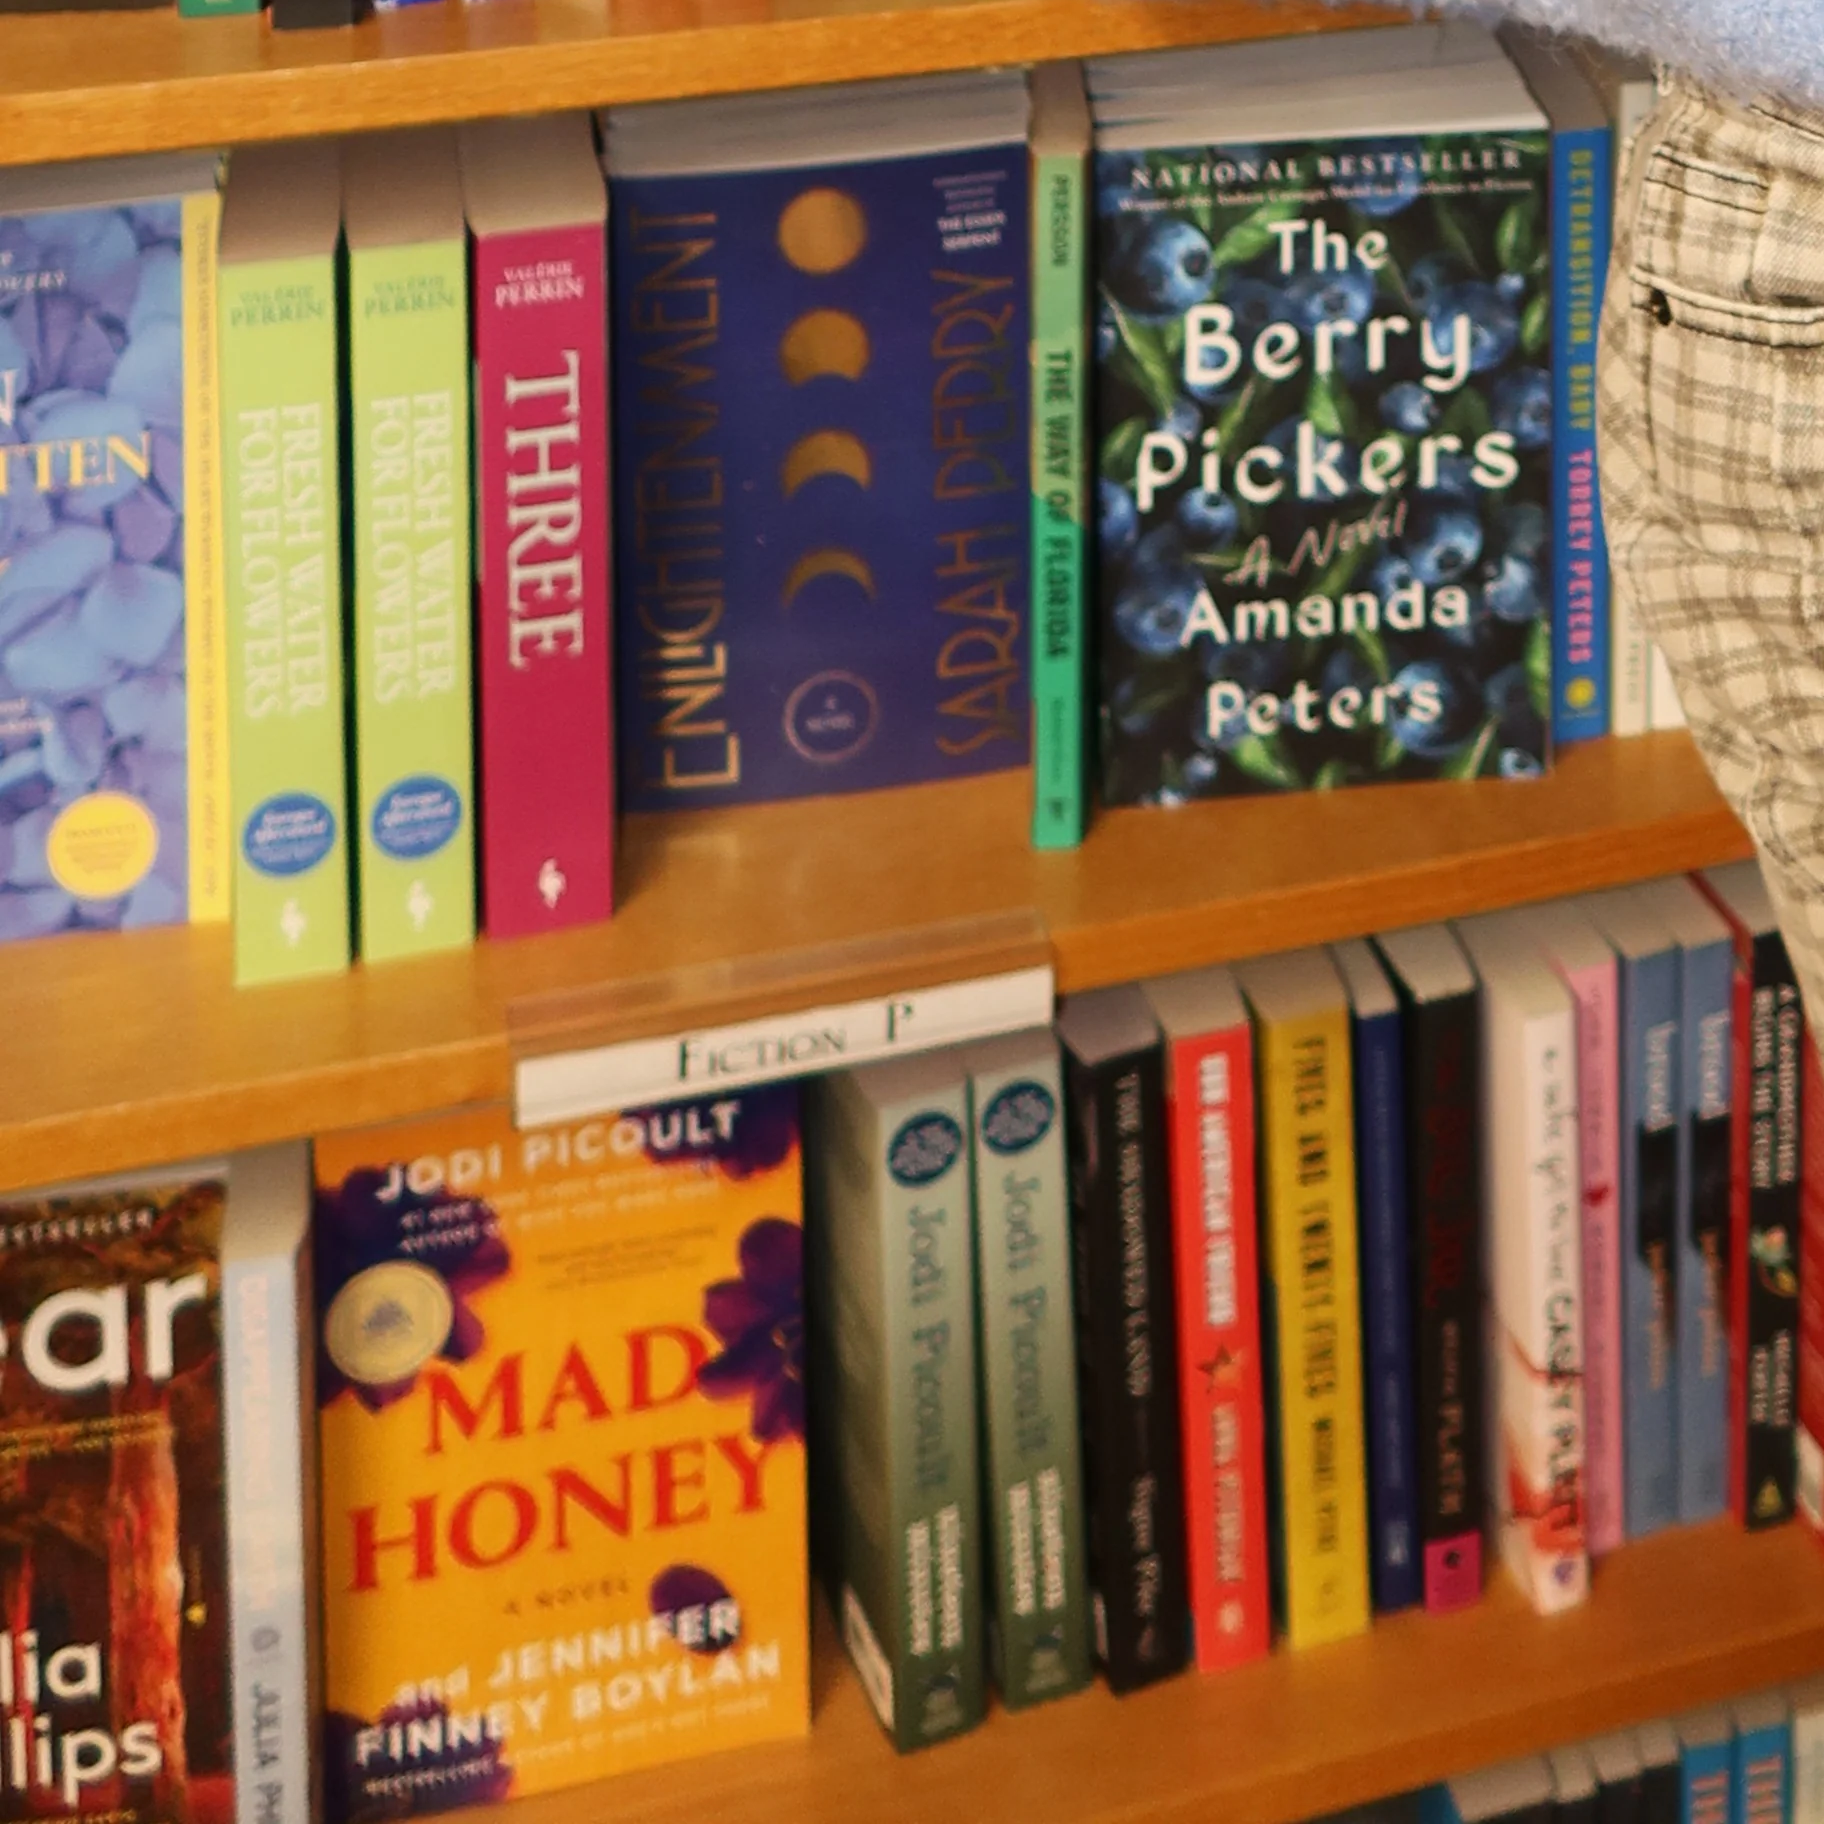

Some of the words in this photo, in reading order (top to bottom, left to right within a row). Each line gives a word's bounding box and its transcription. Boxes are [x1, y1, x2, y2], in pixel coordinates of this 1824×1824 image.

[1268, 219, 1390, 276] The
[1181, 304, 1473, 394] Berry
[239, 406, 278, 504] FOR
[281, 403, 323, 547] FRESH
[1135, 420, 1520, 514] Pickers
[505, 349, 583, 670] THREE
[1224, 536, 1271, 588] A
[1288, 501, 1407, 577] Novel
[239, 513, 283, 722] FLOWERS
[283, 553, 327, 714] WATER
[1181, 583, 1470, 649] Amanda
[1207, 682, 1444, 739] Peters
[885, 999, 916, 1045] P
[376, 1156, 503, 1204] JODI
[521, 1103, 740, 1170] PICOULT
[424, 1322, 709, 1456] MAD
[345, 1432, 775, 1598] HONEY
[488, 1598, 740, 1690] JENNIFER
[354, 1688, 551, 1772] FINNEY
[571, 1650, 780, 1718] BOYLAN
